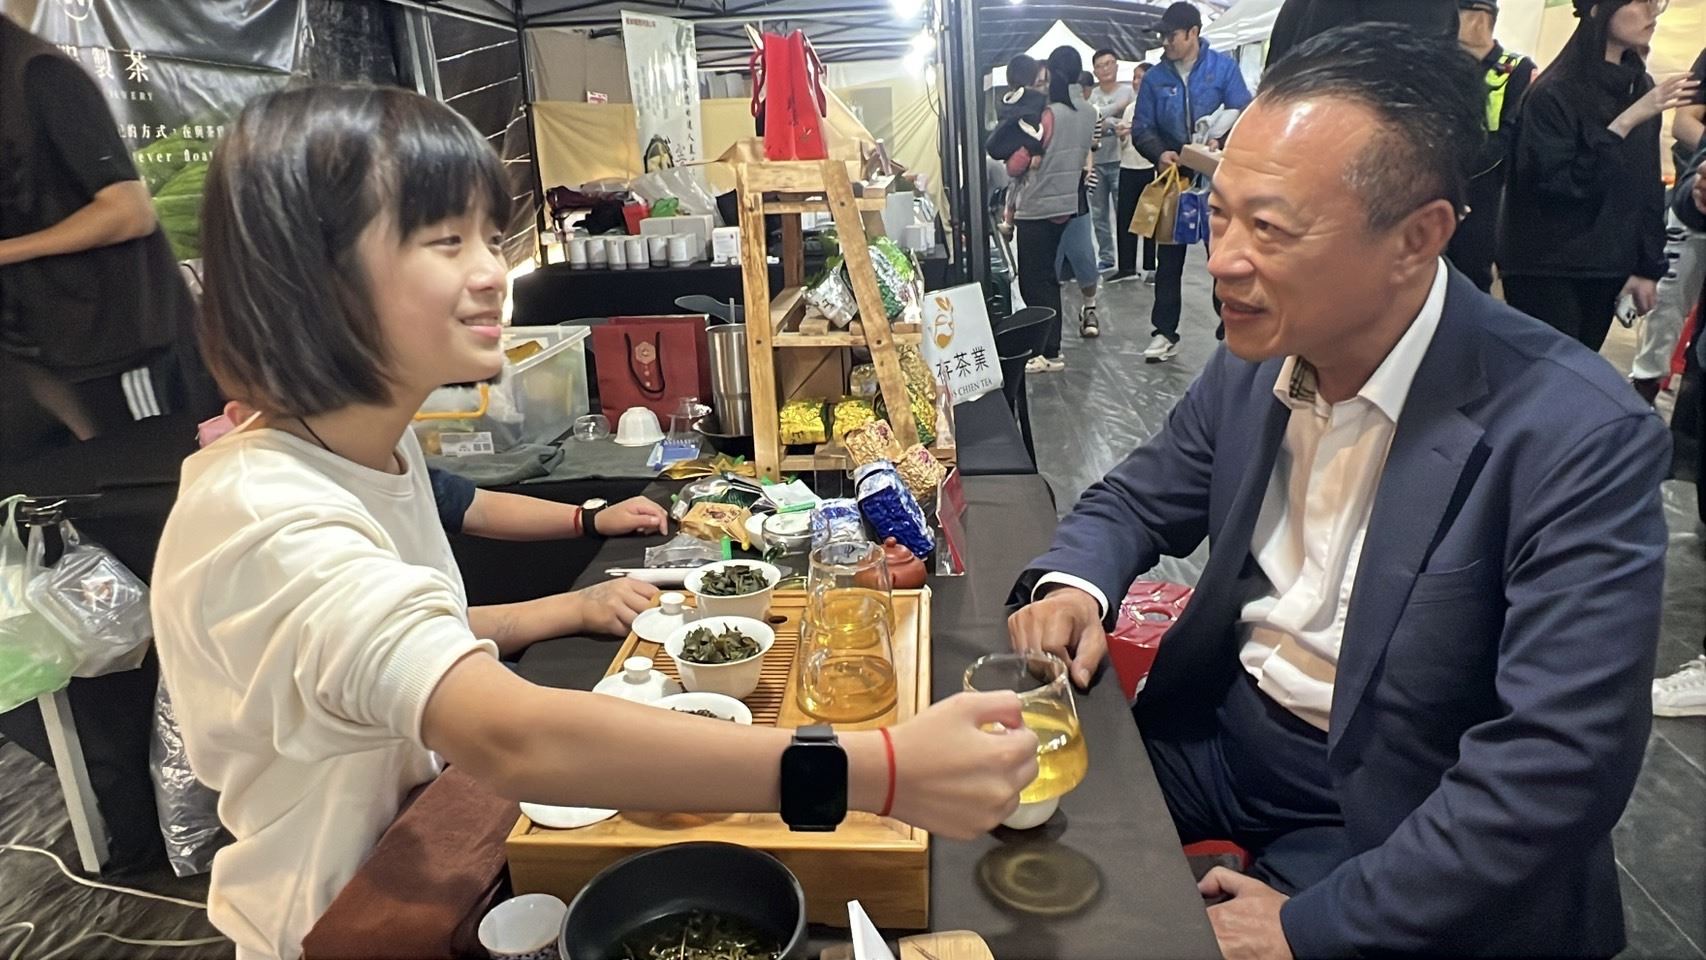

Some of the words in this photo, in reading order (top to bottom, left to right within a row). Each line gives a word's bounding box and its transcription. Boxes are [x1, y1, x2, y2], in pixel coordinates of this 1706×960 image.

[132, 151, 172, 163] ever
[958, 383, 980, 396] CHIEN
[980, 377, 993, 388] TEA
